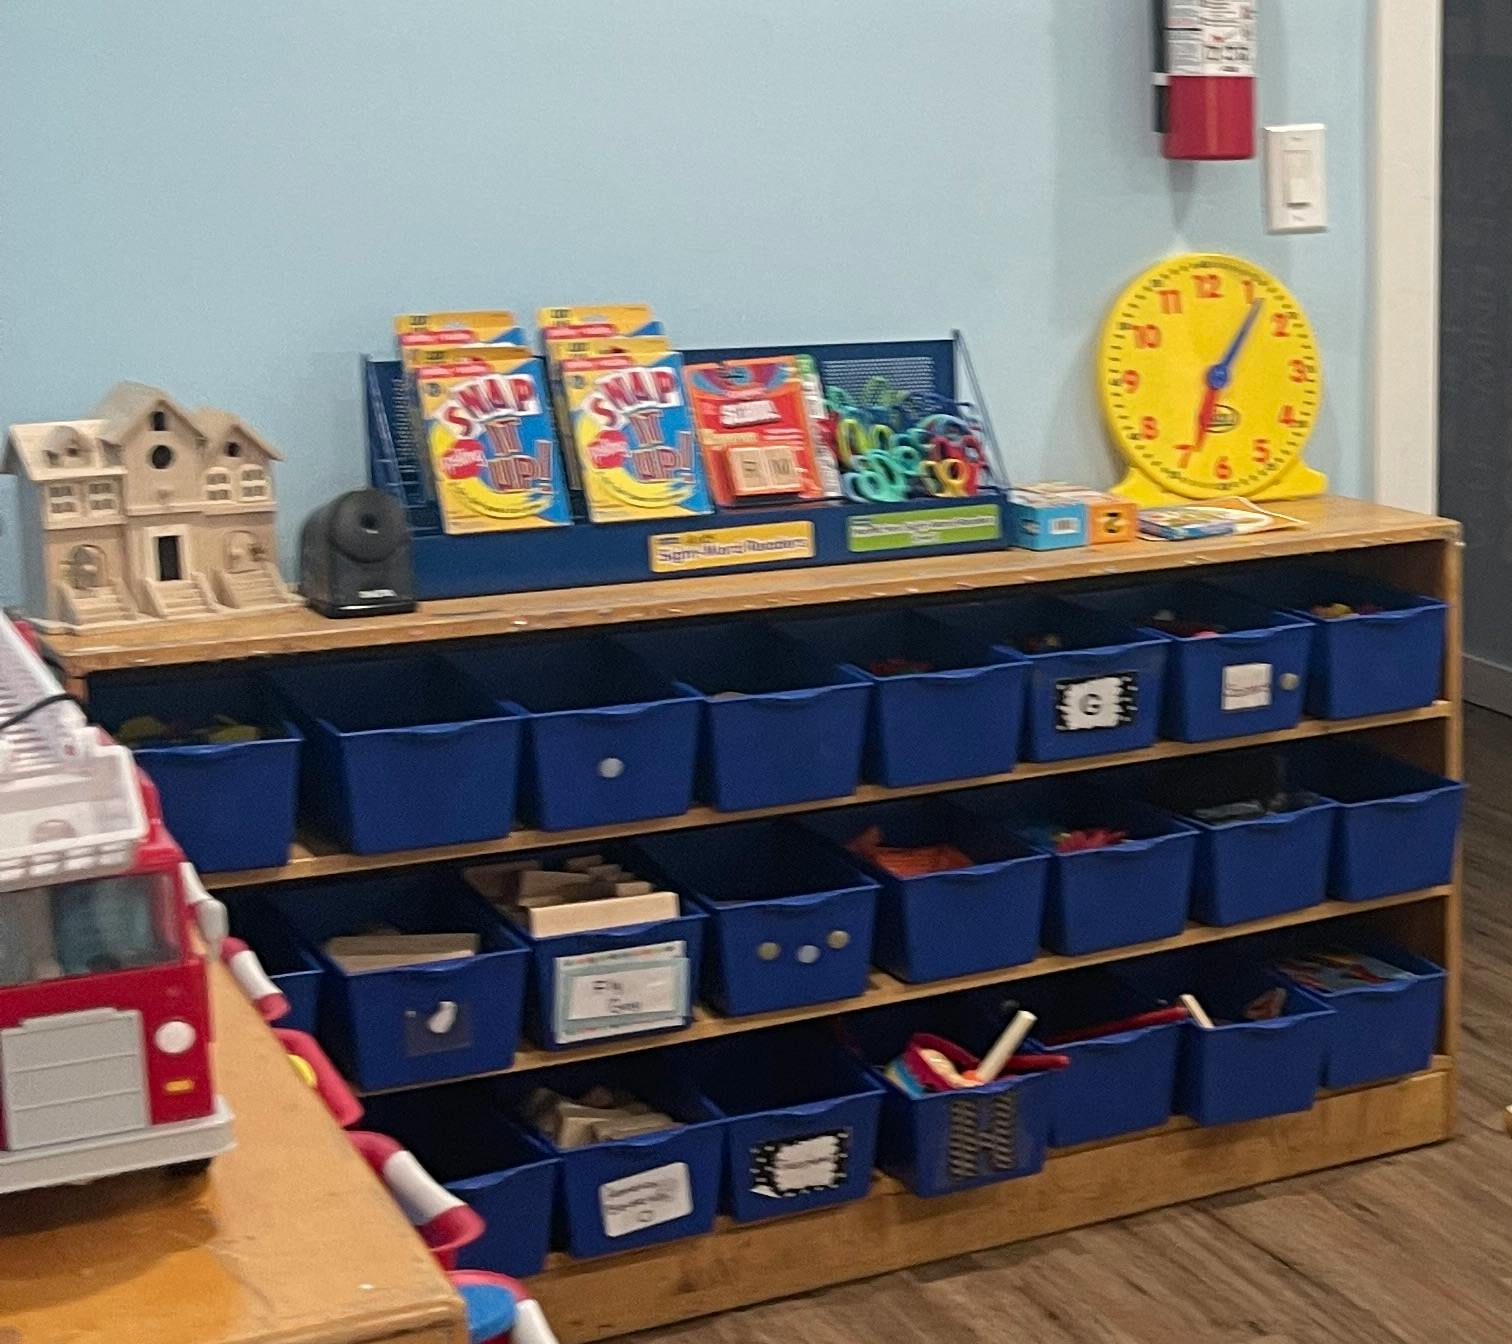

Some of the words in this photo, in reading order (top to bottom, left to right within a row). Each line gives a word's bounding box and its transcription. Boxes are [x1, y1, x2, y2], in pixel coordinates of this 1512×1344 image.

[1191, 274, 1223, 299] 12
[1158, 289, 1183, 314] 11
[1130, 324, 1162, 350] 10
[1271, 312, 1291, 338] 2
[1122, 369, 1140, 394] 9
[1288, 359, 1309, 383] 3
[443, 376, 535, 439] SNAP
[589, 369, 677, 427] SNAP
[1140, 416, 1159, 441] 8
[632, 431, 695, 482] UP!
[1173, 444, 1196, 469] 7
[1252, 439, 1271, 464] 5
[488, 440, 553, 492] UP!
[1215, 456, 1233, 480] 6
[1079, 693, 1101, 715] G
